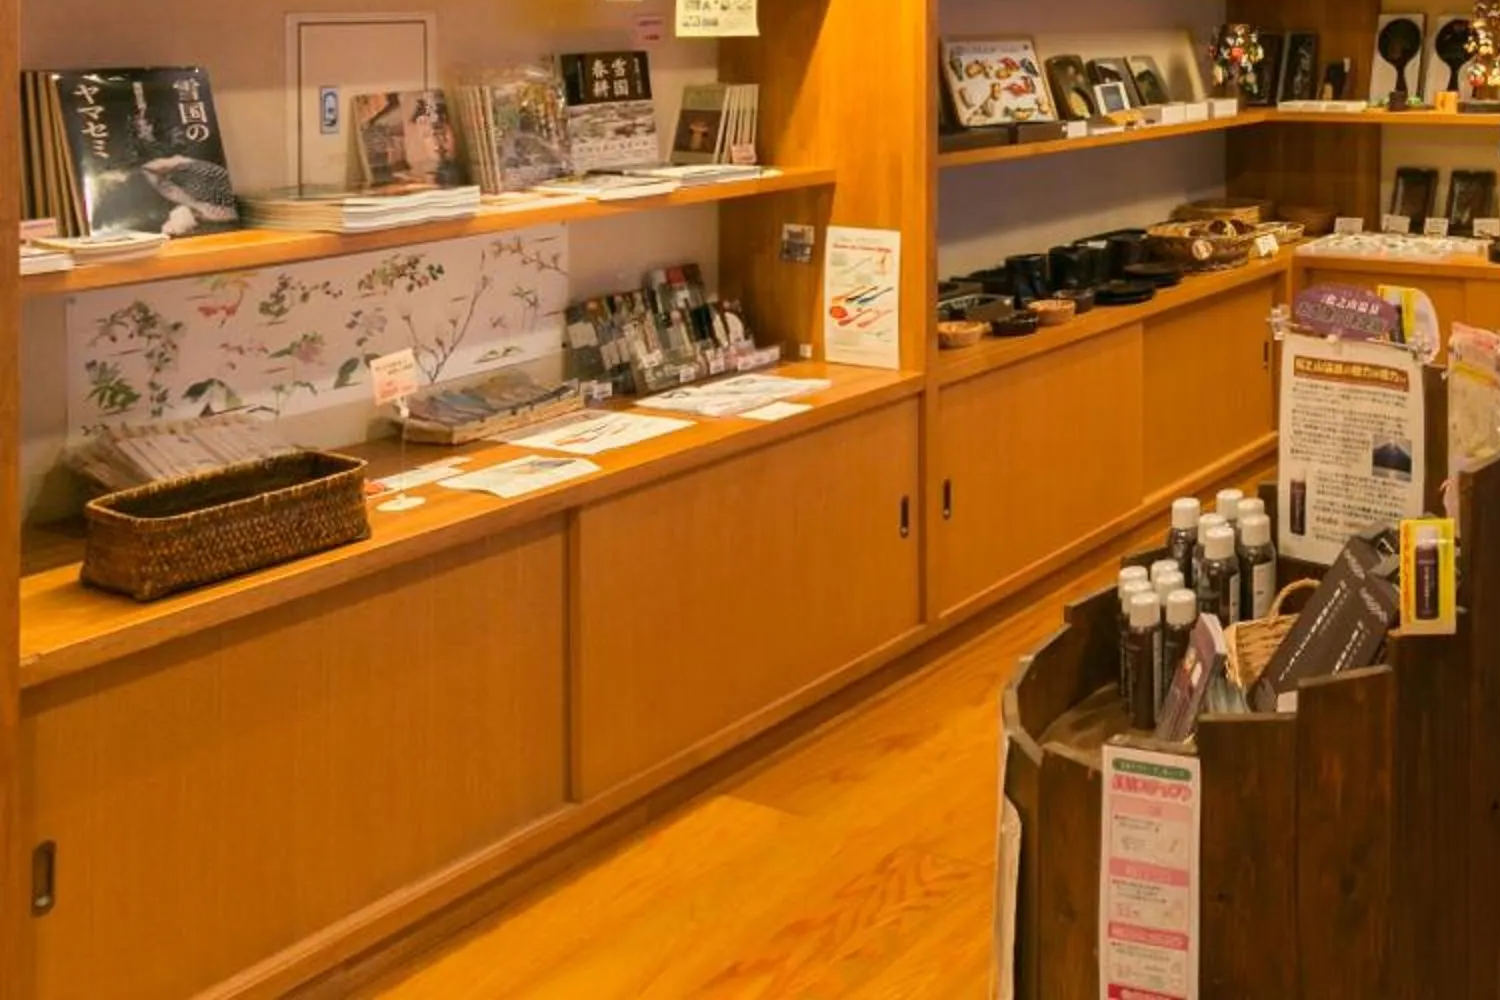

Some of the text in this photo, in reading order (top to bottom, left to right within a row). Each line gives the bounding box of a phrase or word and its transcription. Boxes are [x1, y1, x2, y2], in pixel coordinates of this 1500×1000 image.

[611, 56, 629, 97] 雪国
[73, 83, 110, 160] ヤマセミ
[172, 77, 210, 142] 雪国の
